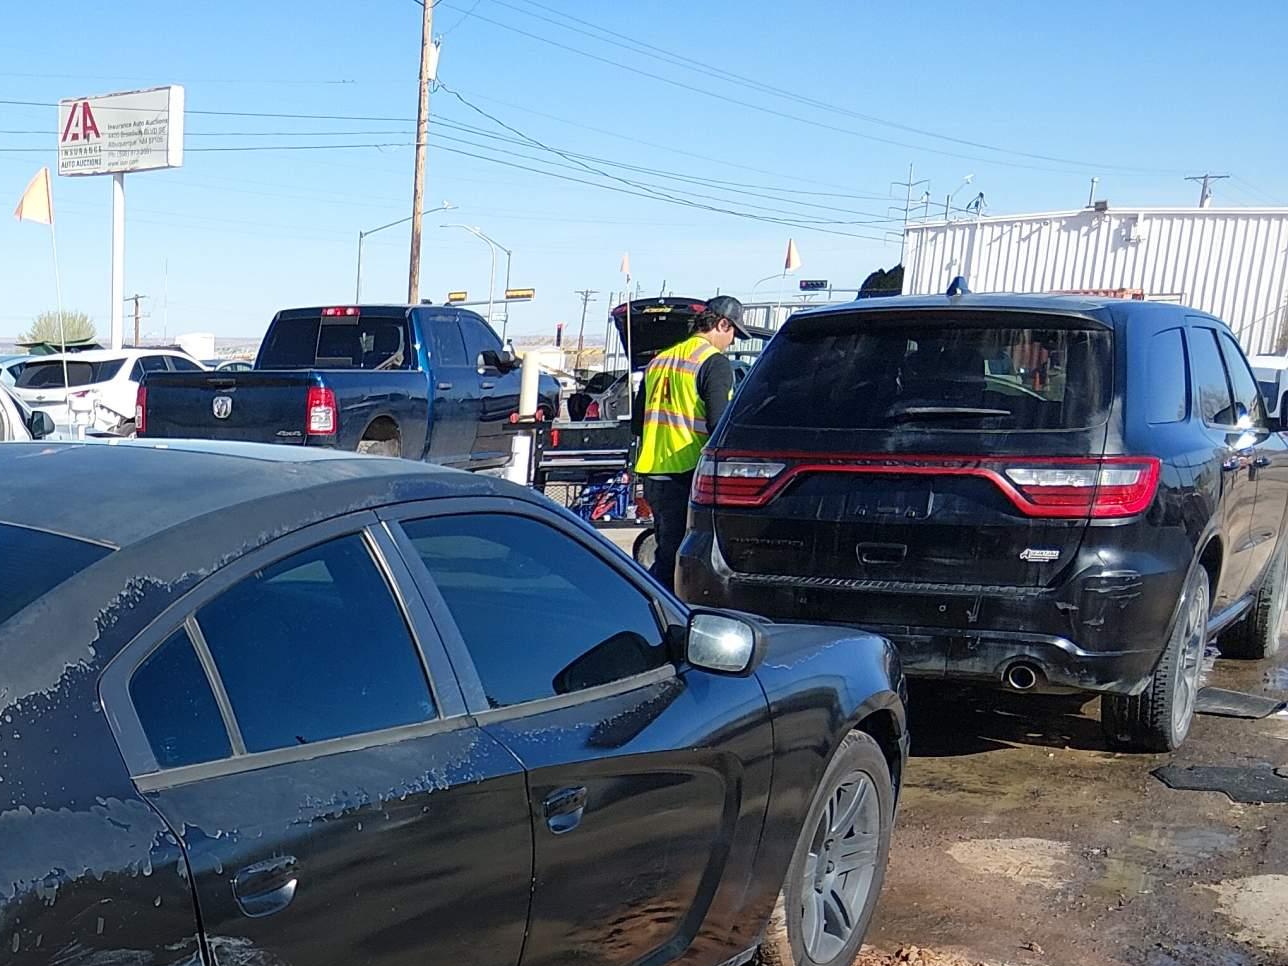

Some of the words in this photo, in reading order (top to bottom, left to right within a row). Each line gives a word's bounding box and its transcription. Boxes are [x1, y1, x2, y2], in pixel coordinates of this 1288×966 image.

[107, 122, 132, 131] Insurance
[145, 118, 168, 126] Auctions
[62, 145, 102, 156] INSURANCE
[61, 160, 75, 169] AUTO
[76, 158, 102, 168] AUCTIONS
